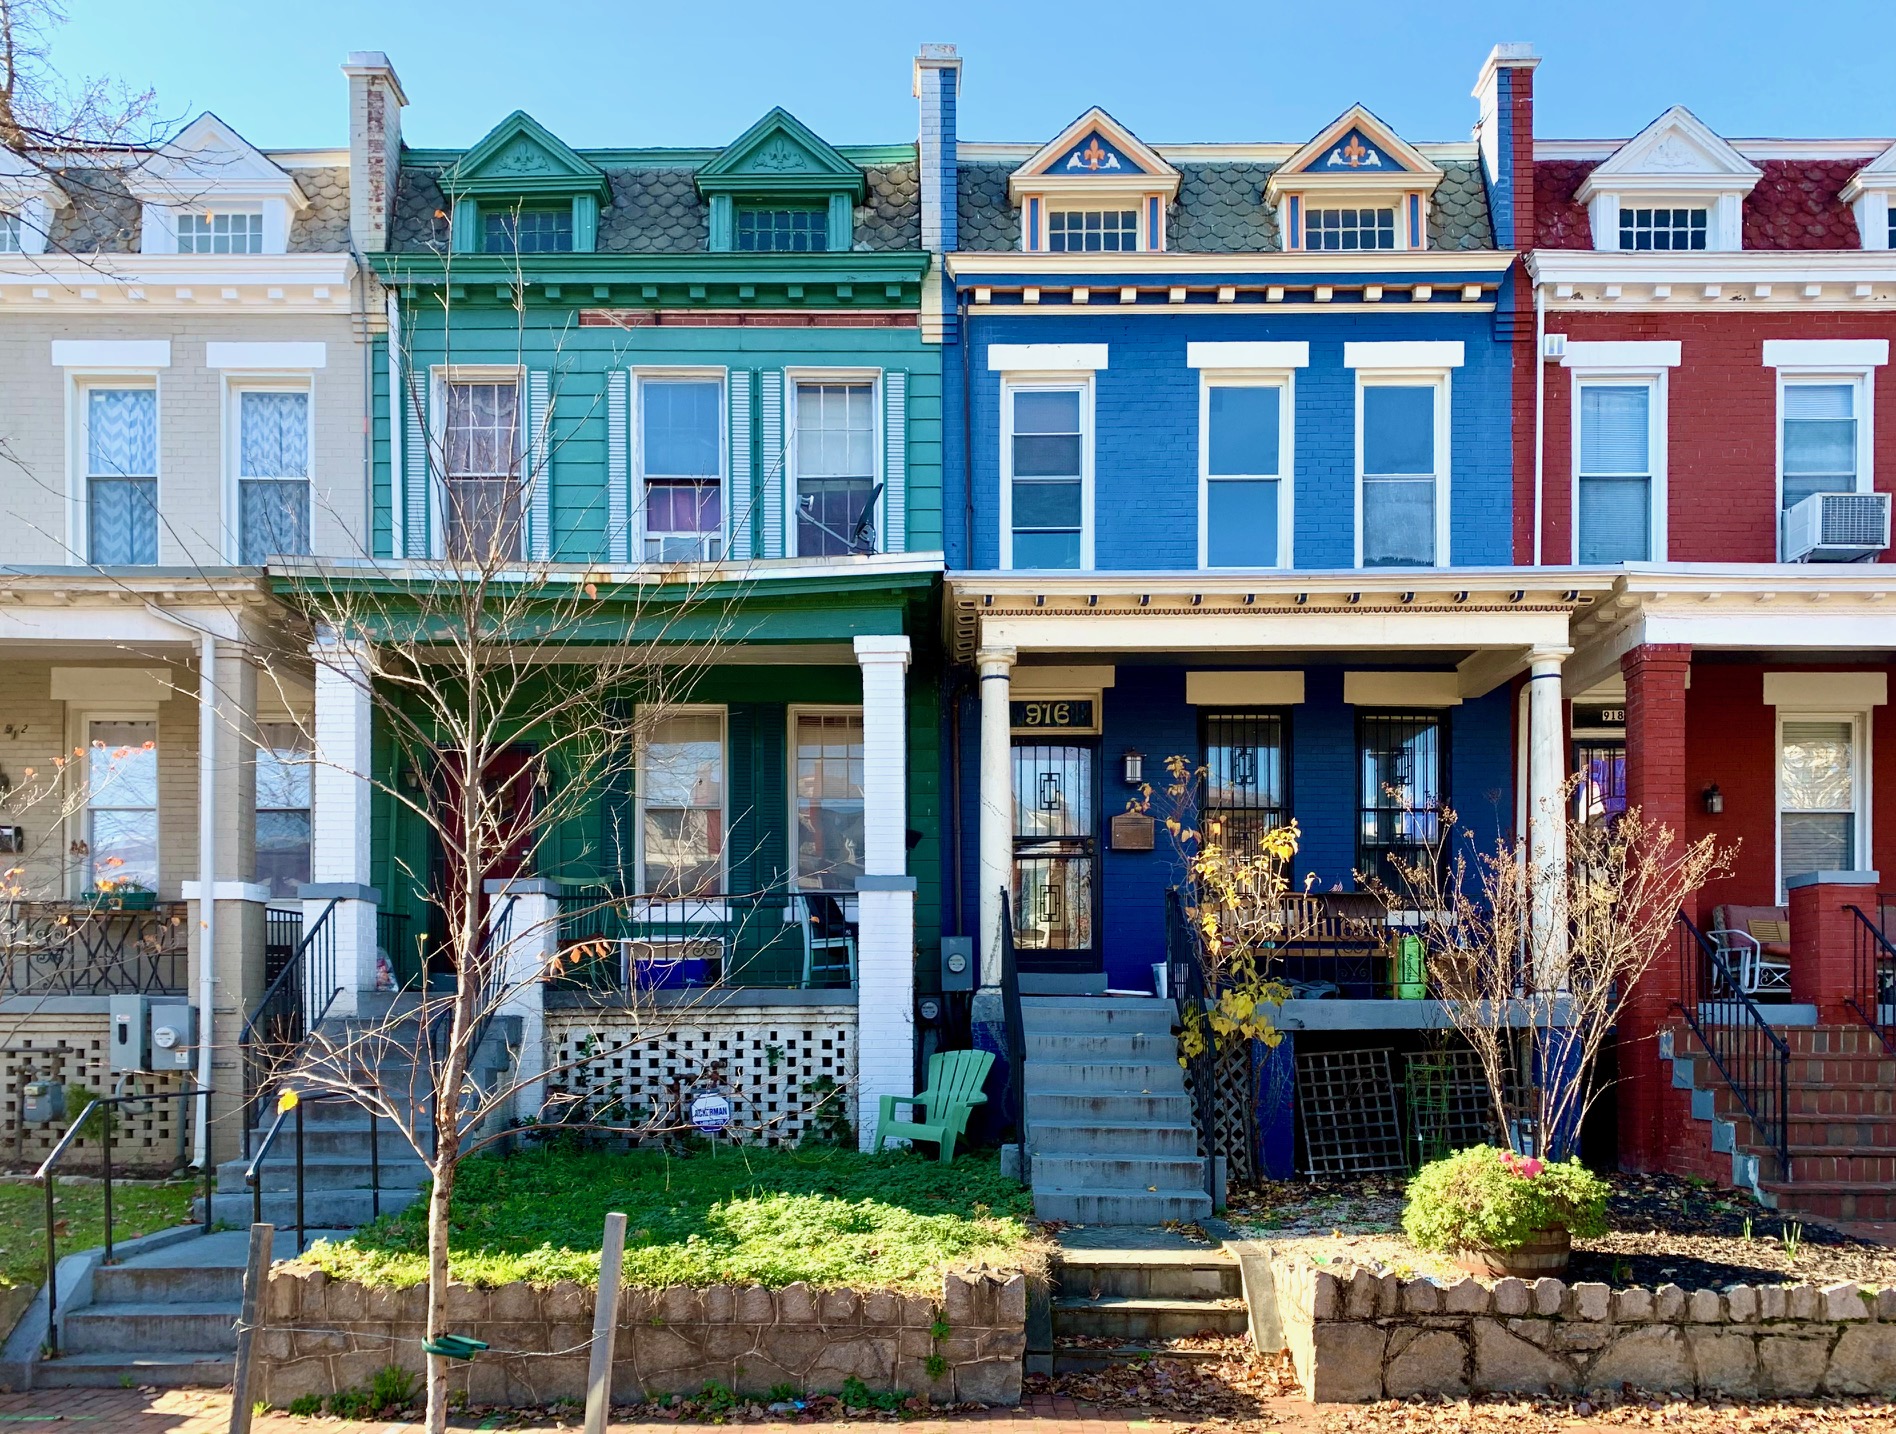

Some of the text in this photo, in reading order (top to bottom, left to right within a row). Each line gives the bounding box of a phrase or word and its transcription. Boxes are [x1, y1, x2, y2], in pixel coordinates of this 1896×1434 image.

[1026, 704, 1069, 724] 916
[1604, 711, 1623, 720] 918
[5, 724, 28, 740] 912
[694, 1107, 727, 1117] ACKERMAN
